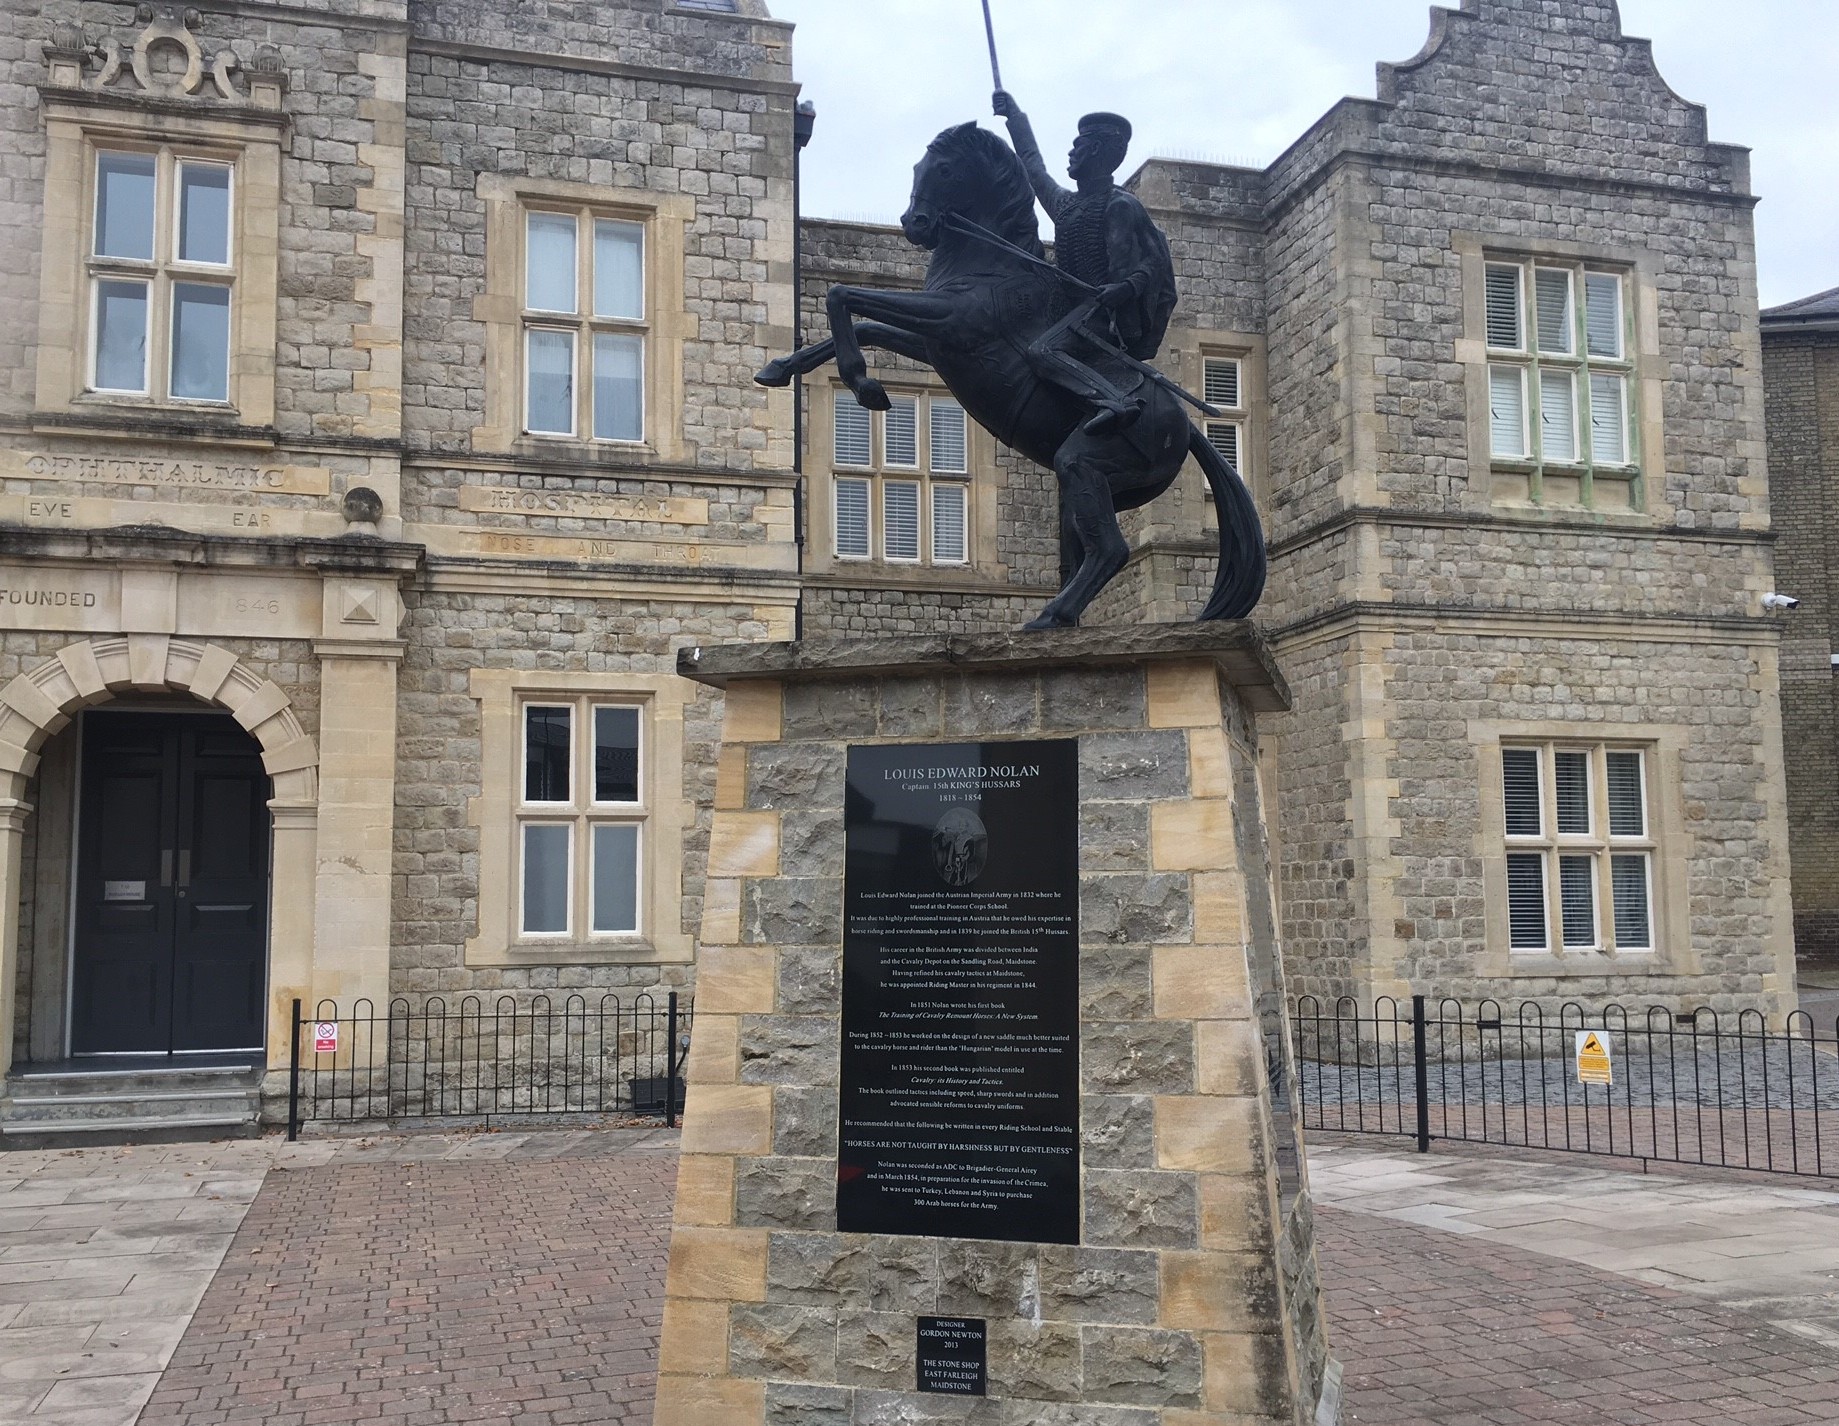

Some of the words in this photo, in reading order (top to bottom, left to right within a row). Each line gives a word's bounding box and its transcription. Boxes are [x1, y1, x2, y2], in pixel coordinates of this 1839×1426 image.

[26, 456, 285, 487] OPHTHALMIC
[491, 490, 673, 519] HOSPITAL
[30, 502, 72, 518] EYE
[233, 512, 271, 527] EAR
[487, 535, 536, 552] NOSE
[577, 540, 617, 557] AND
[652, 544, 721, 561] THROAT
[0, 589, 96, 607] FOUNDED
[884, 767, 923, 780] LOUIS
[928, 766, 986, 779] EDWARD
[990, 765, 1039, 778] NOLAN
[902, 781, 929, 792] Captain
[933, 781, 948, 790] 15th
[981, 780, 1020, 789] HUSSARS
[917, 892, 934, 900] joined
[970, 891, 994, 900] Imperial
[995, 891, 1011, 900] Army
[885, 914, 902, 923] highly
[903, 914, 938, 923] professional
[939, 914, 961, 923] training
[1037, 914, 1063, 923] expertise
[945, 946, 962, 955] Army
[892, 969, 912, 978] Having
[944, 969, 965, 978] cavalry
[923, 1064, 943, 1072] second
[971, 1065, 1000, 1074] published
[854, 1119, 893, 1127] recommended
[916, 1121, 944, 1130] following
[981, 1124, 998, 1132] every
[999, 1123, 1019, 1132] Riding
[1054, 1125, 1072, 1133] Stable
[876, 1141, 890, 1149] ARE
[908, 1142, 935, 1150] TAUGHT
[937, 1143, 948, 1151] BY
[949, 1143, 992, 1152] HARSHNESS
[1009, 1145, 1020, 1153] BY
[877, 1160, 895, 1168] Nolan
[958, 1163, 965, 1171] to
[1020, 1166, 1037, 1175] Airey
[867, 1172, 877, 1180] and
[885, 1173, 903, 1181] March
[927, 1175, 960, 1185] preparation
[980, 1177, 1005, 1185] invasion
[982, 1189, 998, 1199] Syria
[1006, 1190, 1032, 1200] purchase
[914, 1198, 924, 1206] 300
[925, 1199, 939, 1207] Arab
[940, 1200, 959, 1208] horses
[970, 1201, 979, 1209] the
[952, 1331, 982, 1339] NEWTON
[931, 1382, 971, 1390] MAIDSTONE
